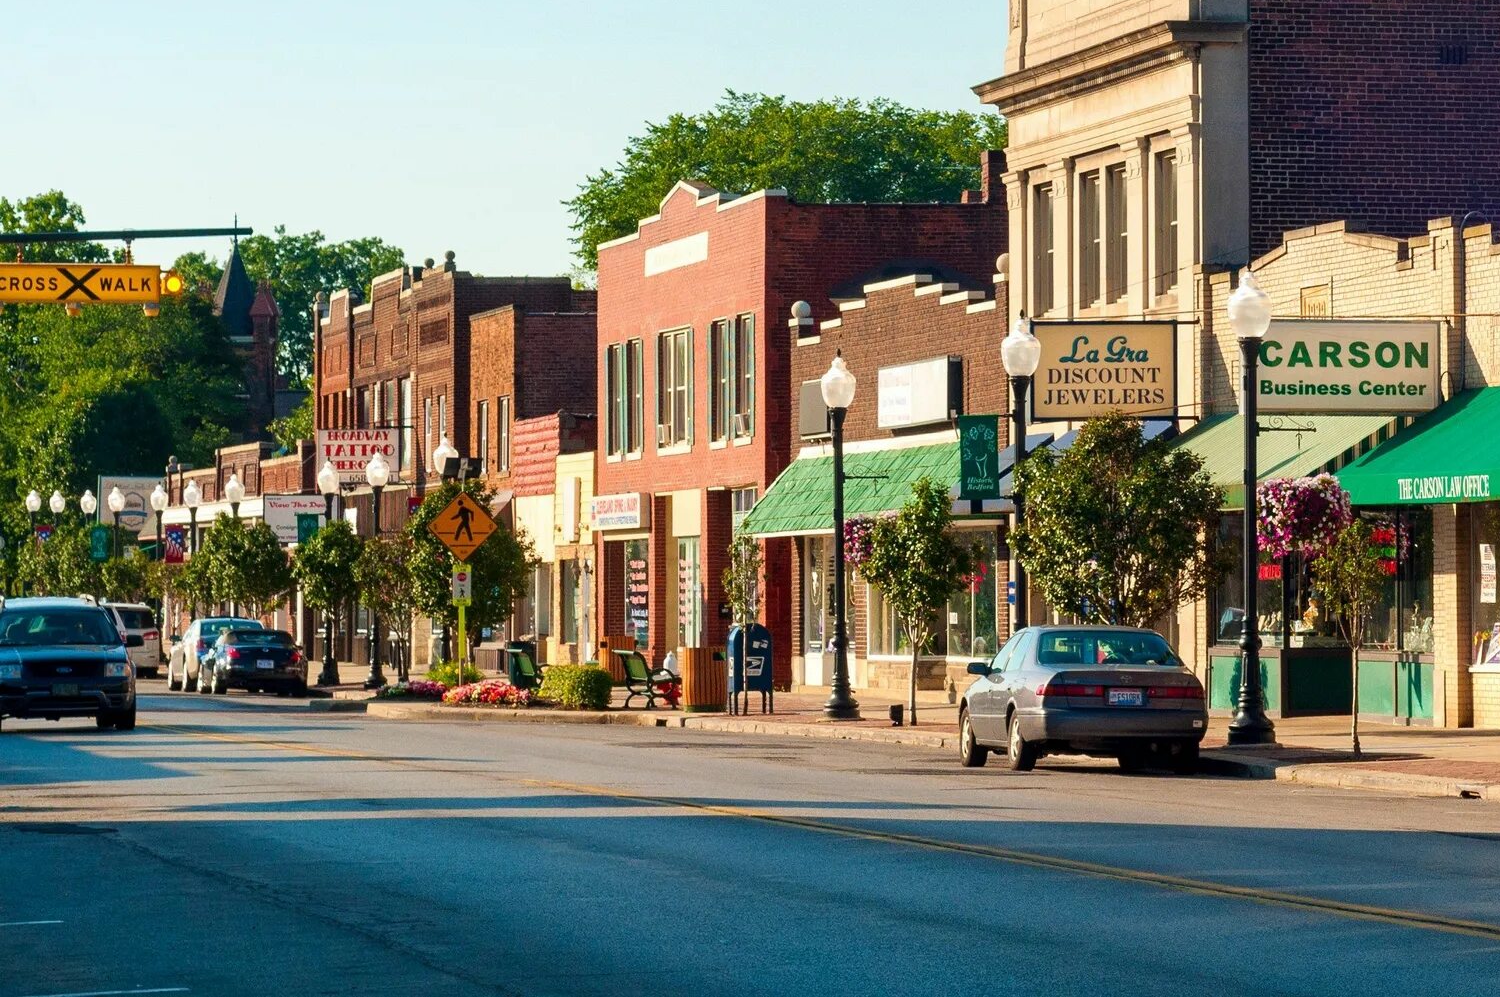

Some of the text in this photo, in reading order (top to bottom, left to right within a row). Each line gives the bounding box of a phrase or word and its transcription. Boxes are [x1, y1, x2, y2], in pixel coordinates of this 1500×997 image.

[0, 277, 152, 292] CROSS WALK
[1059, 335, 1149, 363] La Gra
[1259, 340, 1429, 369] CARSON
[1047, 367, 1161, 385] DISCOUNT
[1260, 379, 1427, 396] Business Center
[1043, 388, 1165, 405] JEWELERS
[327, 431, 390, 441] BROADWAY
[322, 444, 396, 457] TATTOO
[1398, 474, 1490, 500] THE CARSON LAW OFFICE
